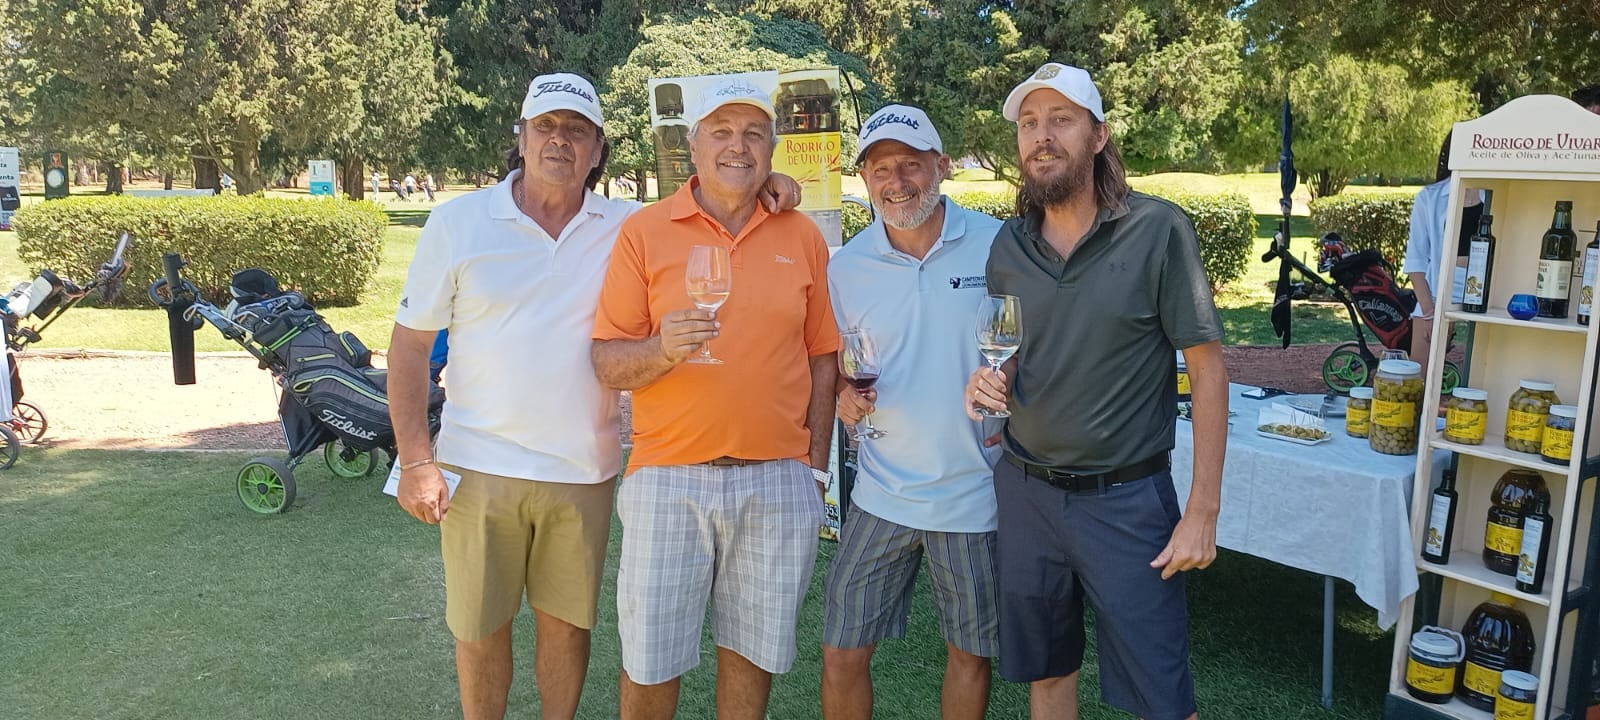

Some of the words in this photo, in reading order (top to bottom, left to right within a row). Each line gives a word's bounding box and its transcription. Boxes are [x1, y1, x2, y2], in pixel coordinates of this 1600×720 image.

[533, 81, 594, 103] Titleist
[863, 113, 920, 139] Titleist
[786, 140, 835, 154] RODRIGO
[1472, 133, 1534, 150] RODRIGO
[1537, 138, 1552, 149] DE
[1556, 133, 1600, 150] VIVAR
[788, 156, 799, 166] DE
[1469, 151, 1497, 159] Aceite
[1500, 150, 1512, 159] de
[1516, 151, 1540, 159] Oliva
[1544, 153, 1549, 161] y
[1552, 151, 1600, 160] Acetuna
[318, 409, 377, 440] Titleist
